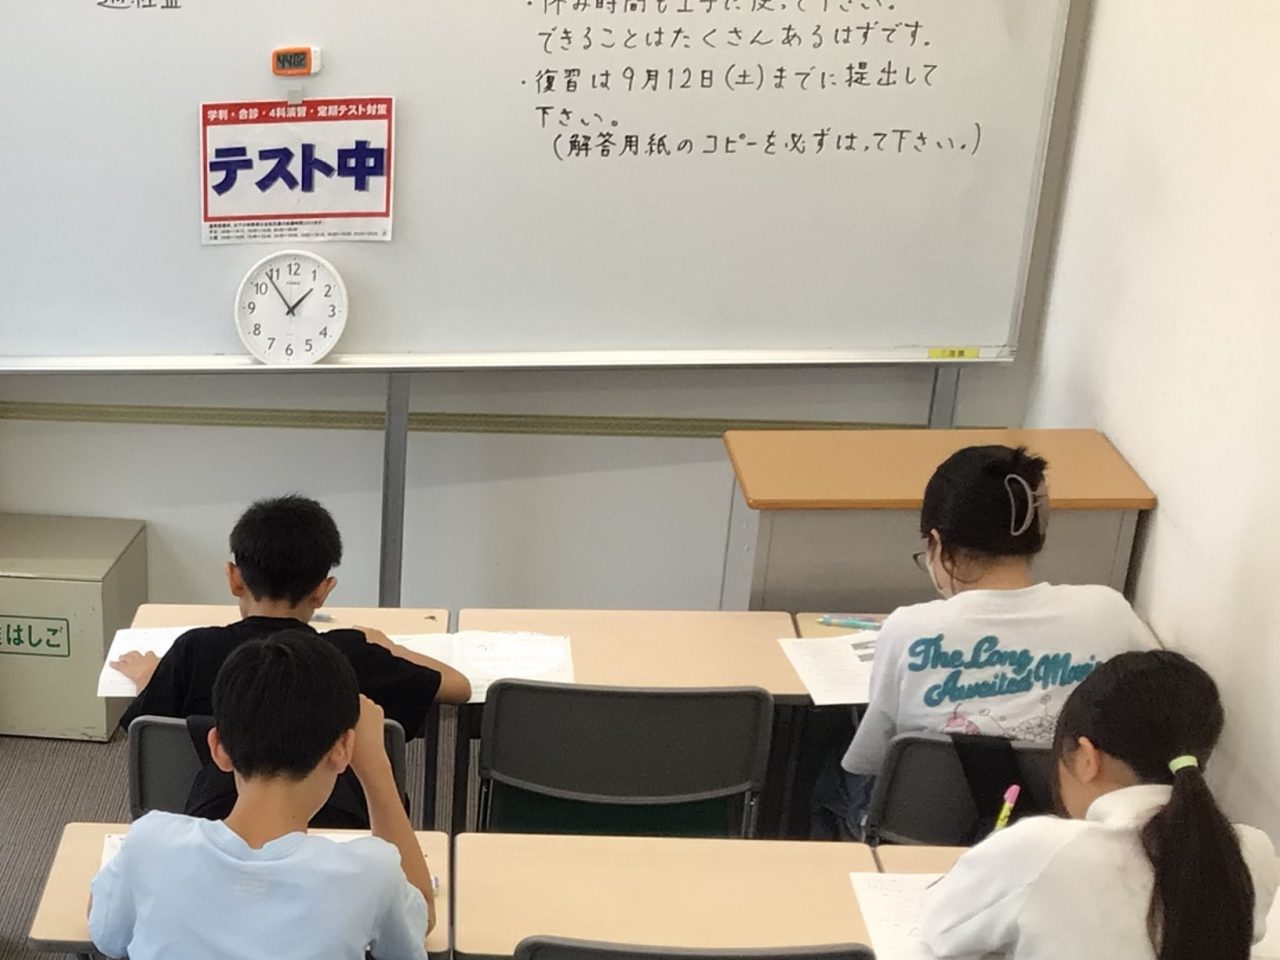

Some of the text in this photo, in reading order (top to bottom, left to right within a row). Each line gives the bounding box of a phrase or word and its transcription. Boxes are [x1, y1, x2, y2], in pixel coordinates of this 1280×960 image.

[535, 106, 618, 128] 下さい。
[209, 140, 386, 196] テスト中
[287, 262, 301, 276] 12
[311, 269, 317, 282] 1
[254, 282, 268, 296] 10
[323, 284, 332, 298] 2
[247, 301, 256, 315] 9
[328, 304, 336, 318] 3
[253, 323, 261, 337] 8
[319, 326, 328, 339] 4
[267, 337, 276, 350] 7
[285, 343, 294, 357] 6
[304, 339, 313, 352] 5
[908, 634, 965, 671] The
[963, 635, 1034, 676] Long
